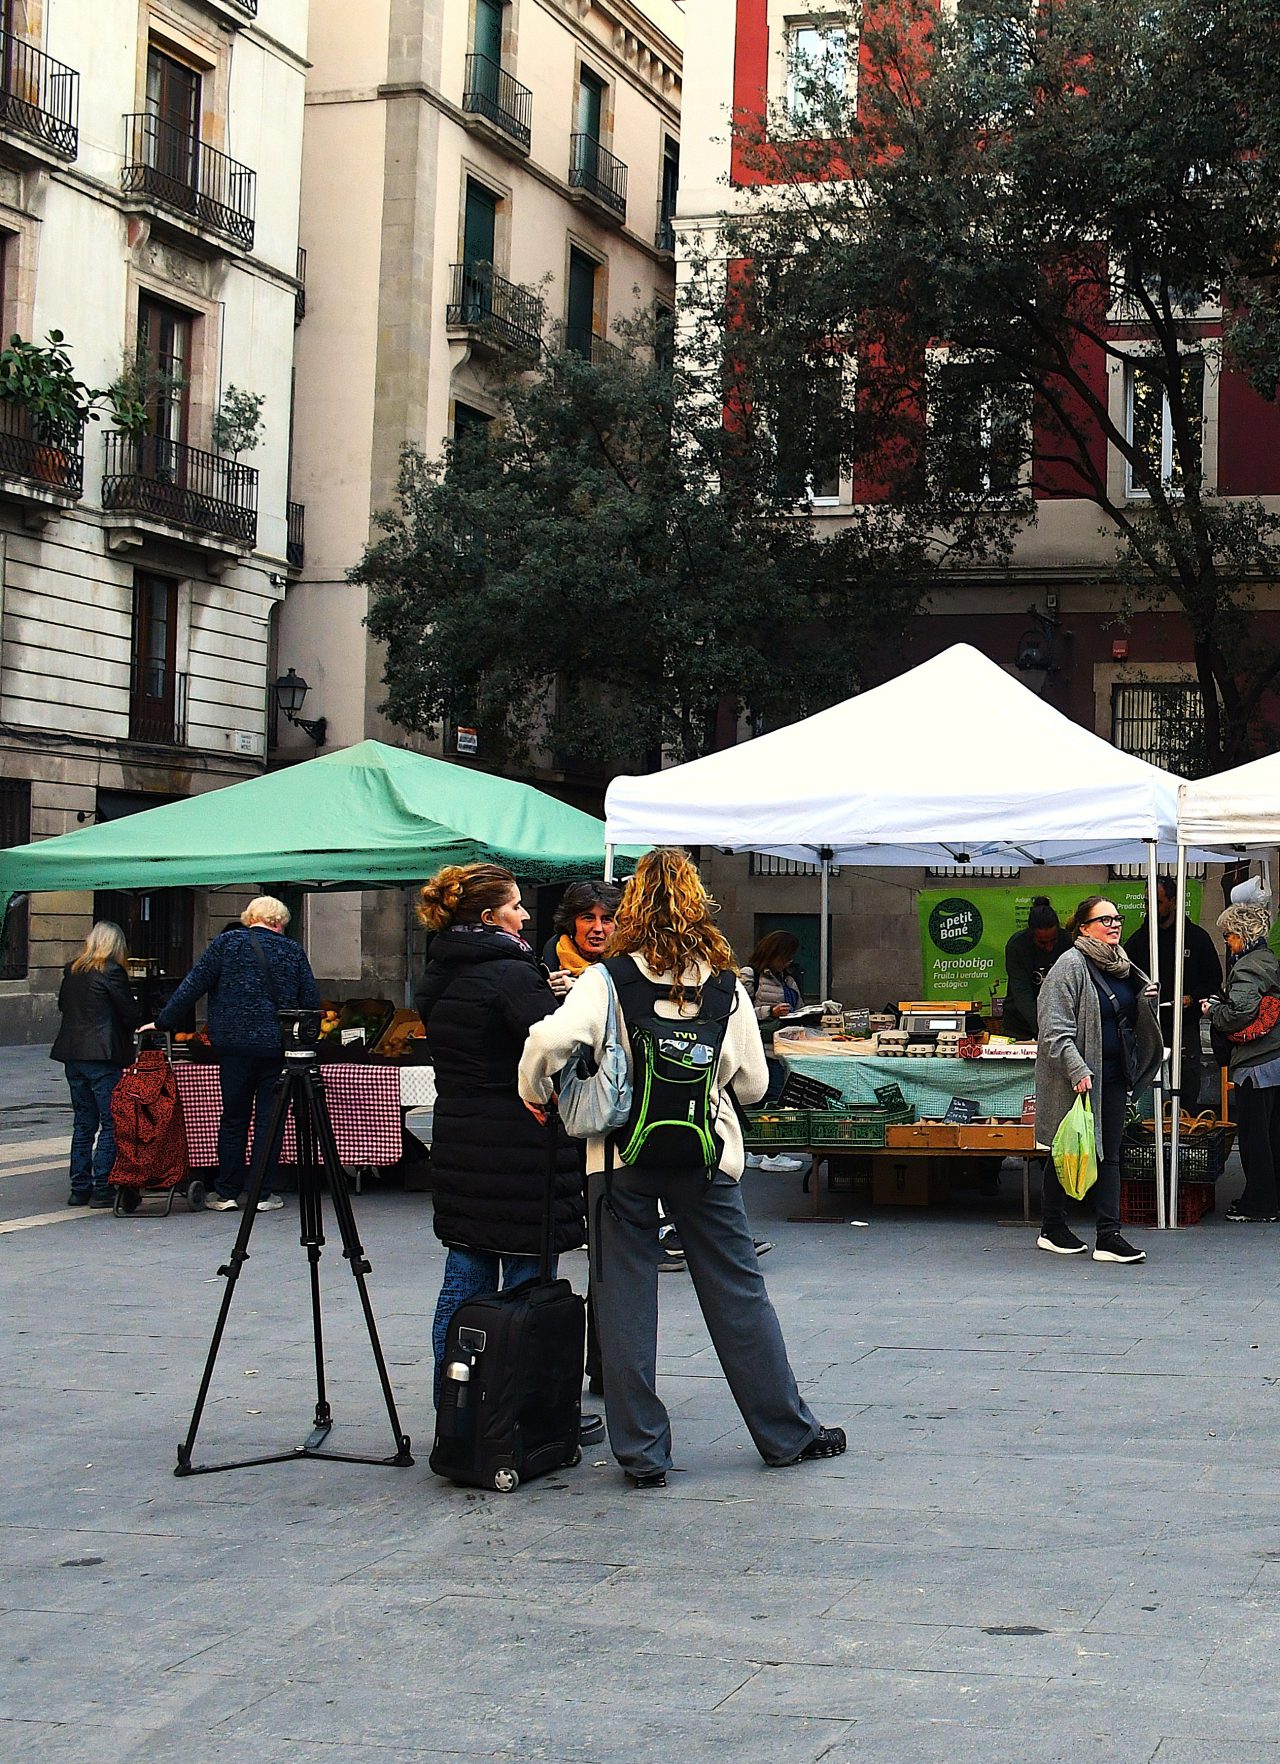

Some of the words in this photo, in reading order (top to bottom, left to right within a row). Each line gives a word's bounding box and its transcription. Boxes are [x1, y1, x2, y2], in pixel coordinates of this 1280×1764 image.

[946, 911, 973, 930] petit
[940, 923, 969, 940] Bané
[933, 957, 994, 972] Agrobotiga
[933, 972, 955, 980] Fruita
[960, 971, 989, 979] verdura
[672, 1031, 697, 1040] TVU
